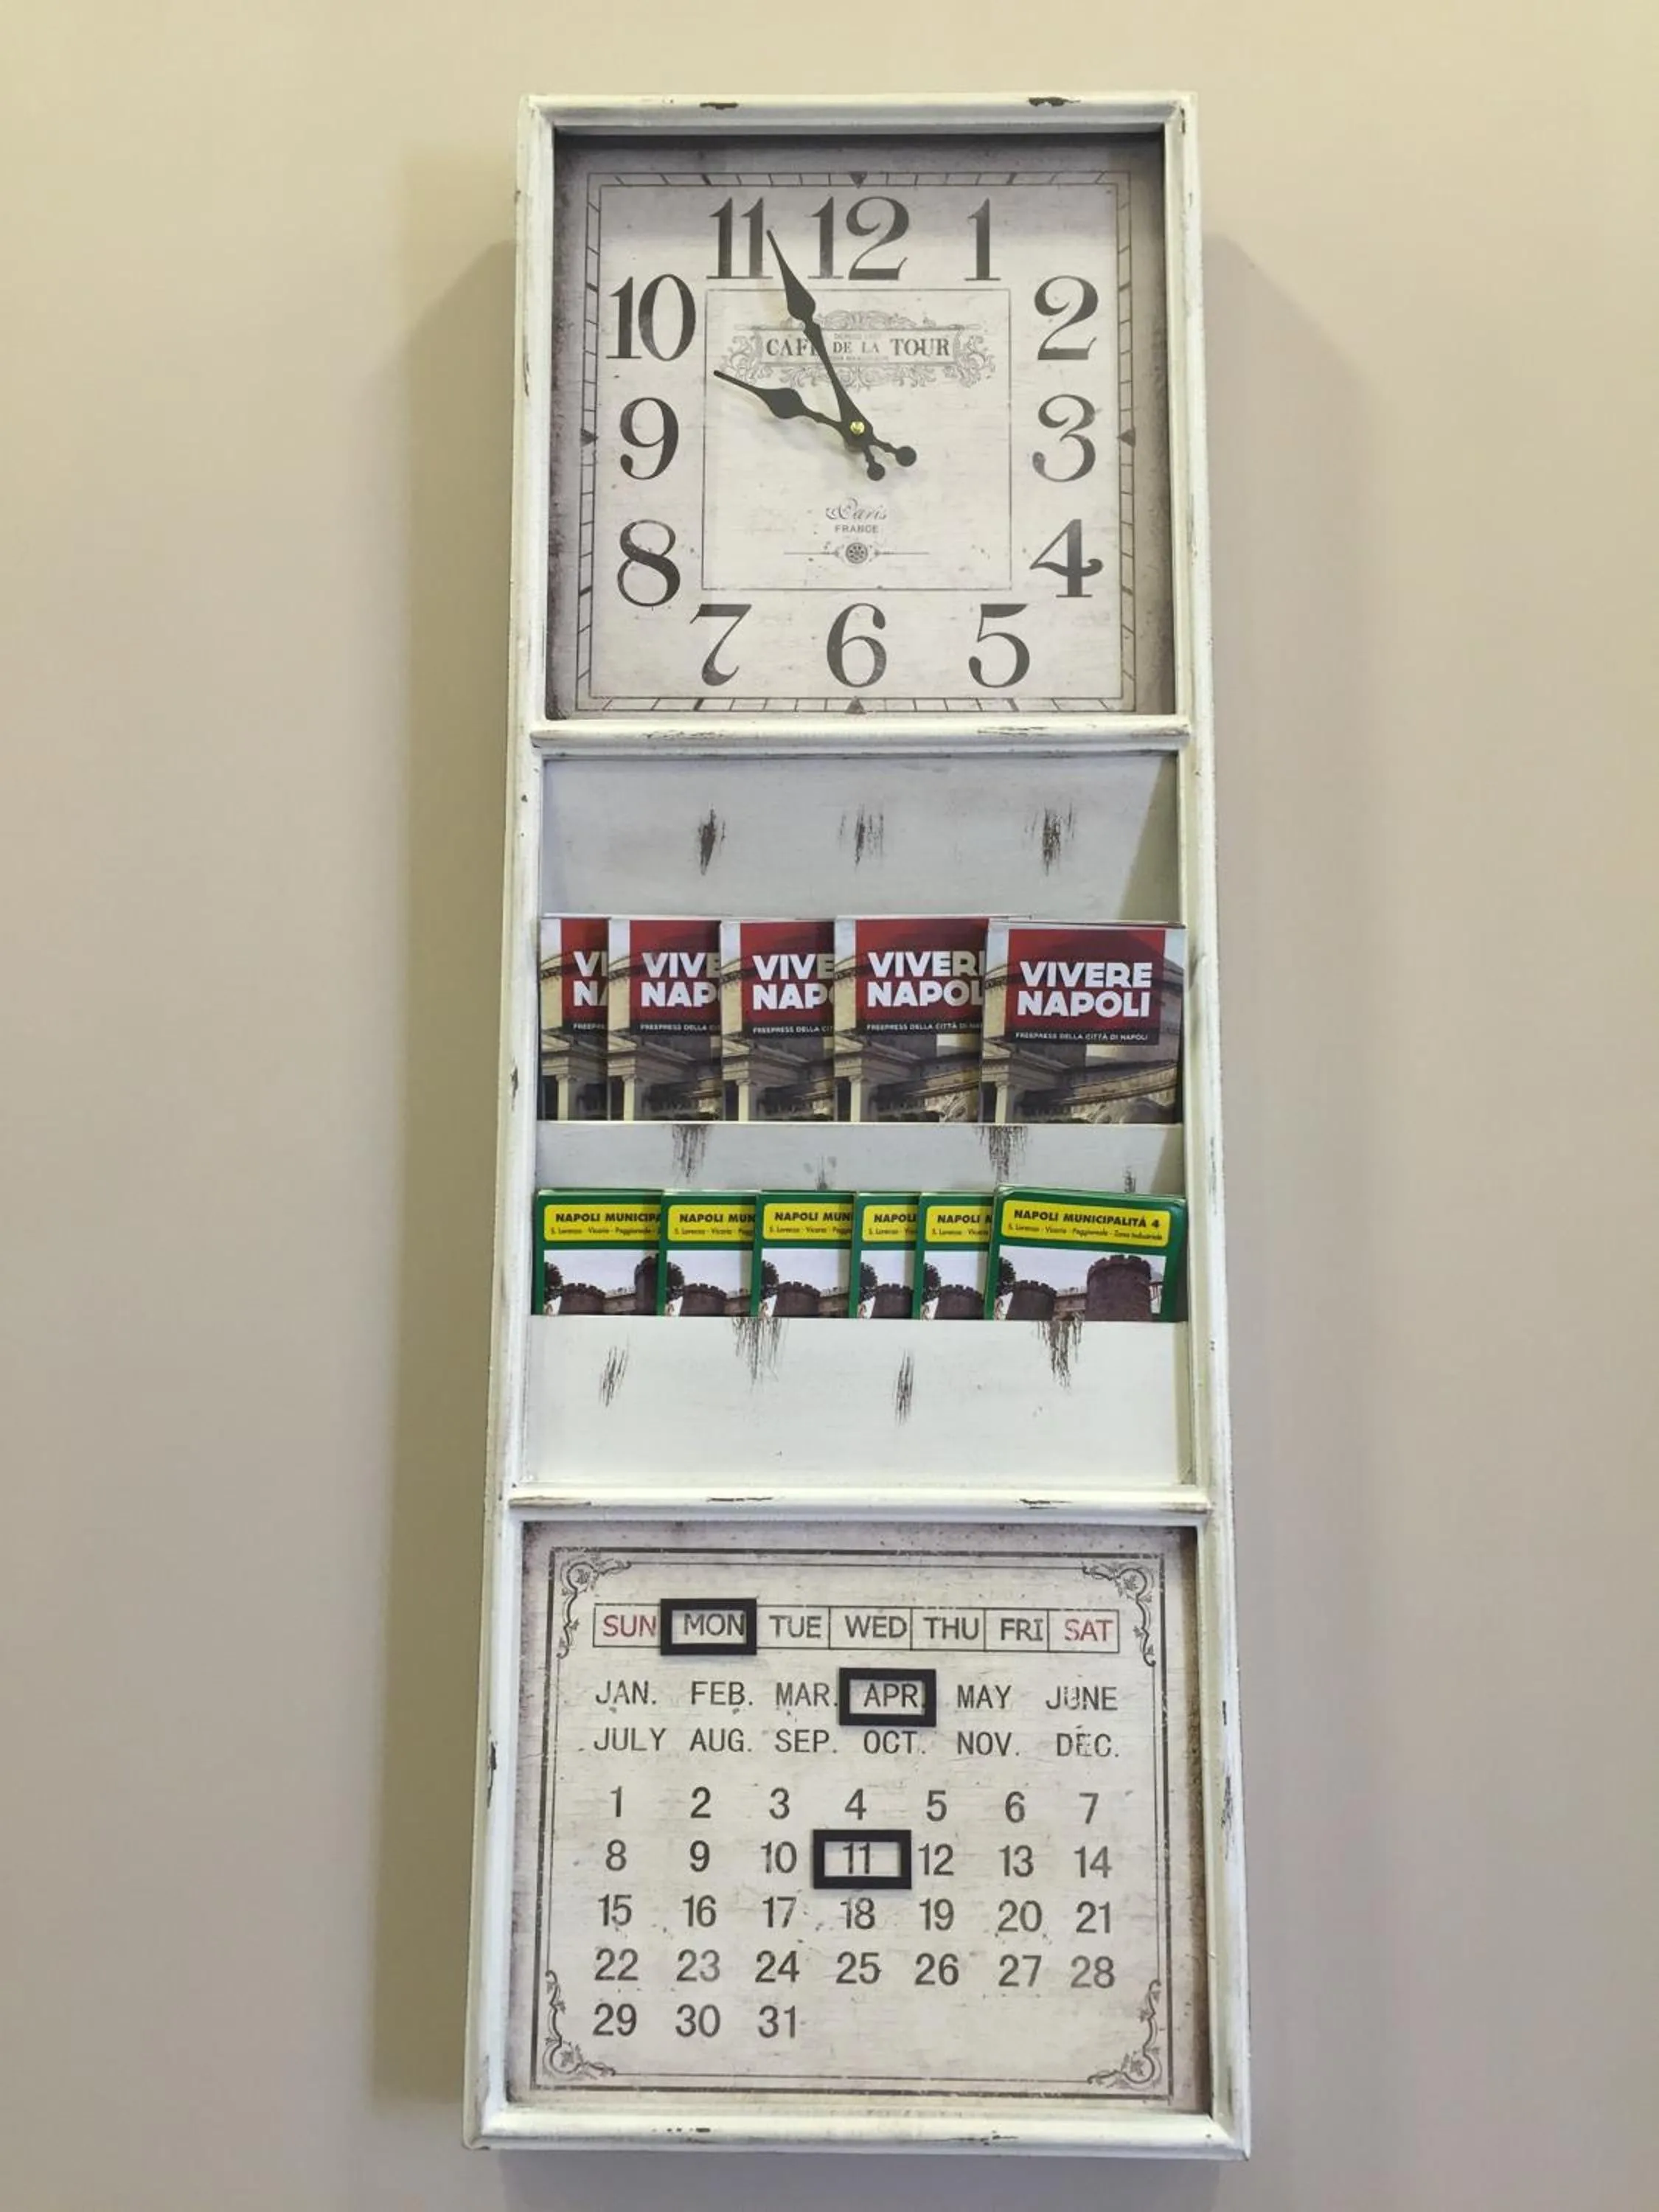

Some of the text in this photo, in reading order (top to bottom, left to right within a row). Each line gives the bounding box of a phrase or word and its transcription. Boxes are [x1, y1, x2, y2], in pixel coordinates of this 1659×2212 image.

[706, 196, 772, 280] 11
[807, 195, 911, 281] 12
[964, 198, 1001, 281] 1
[606, 274, 697, 362] 10
[1034, 275, 1099, 361] 2
[832, 341, 852, 354] DE
[862, 341, 880, 354] LA
[890, 338, 950, 356] TOUR
[619, 397, 679, 481] 9
[1032, 394, 1096, 483] 3
[834, 524, 879, 533] FRANCE
[616, 519, 681, 608] 8
[1030, 518, 1104, 598] 4
[690, 604, 752, 686] 7
[827, 602, 886, 689] 6
[968, 604, 1030, 689] 5
[641, 981, 720, 1007] NAP
[1020, 961, 1152, 988] VIVERE
[753, 984, 835, 1010] NAP
[1017, 990, 1151, 1018] NAPOLI
[556, 1213, 600, 1222] NAPOLI
[679, 1214, 724, 1222] NAPOLI
[774, 1212, 818, 1221] NAPOLI
[937, 1215, 980, 1223] NAPOLI
[1014, 1209, 1058, 1221] NAPOLI
[1151, 1219, 1161, 1228] 4
[602, 1613, 1114, 1642] SUN MON TUE WED THU FRI SAT
[595, 1680, 657, 1704] JAN.
[691, 1680, 754, 1705] FEB.
[775, 1681, 838, 1707] MAR.
[957, 1684, 1012, 1709] MAY
[1046, 1686, 1118, 1711] JUNE
[593, 1727, 1119, 1758] JULY AUG. SEP. OCT. NOV. DEC.
[611, 1786, 1099, 1825] 1 2 3 4 5 6 7
[605, 1839, 1113, 1879] 8 9 10 11 12 13 14
[598, 1893, 1110, 1934] 15 16 17 18 19 20 21
[594, 1947, 1116, 1989] 22 23 24 25 26 27 28
[592, 2003, 796, 2039] 29 30 31
